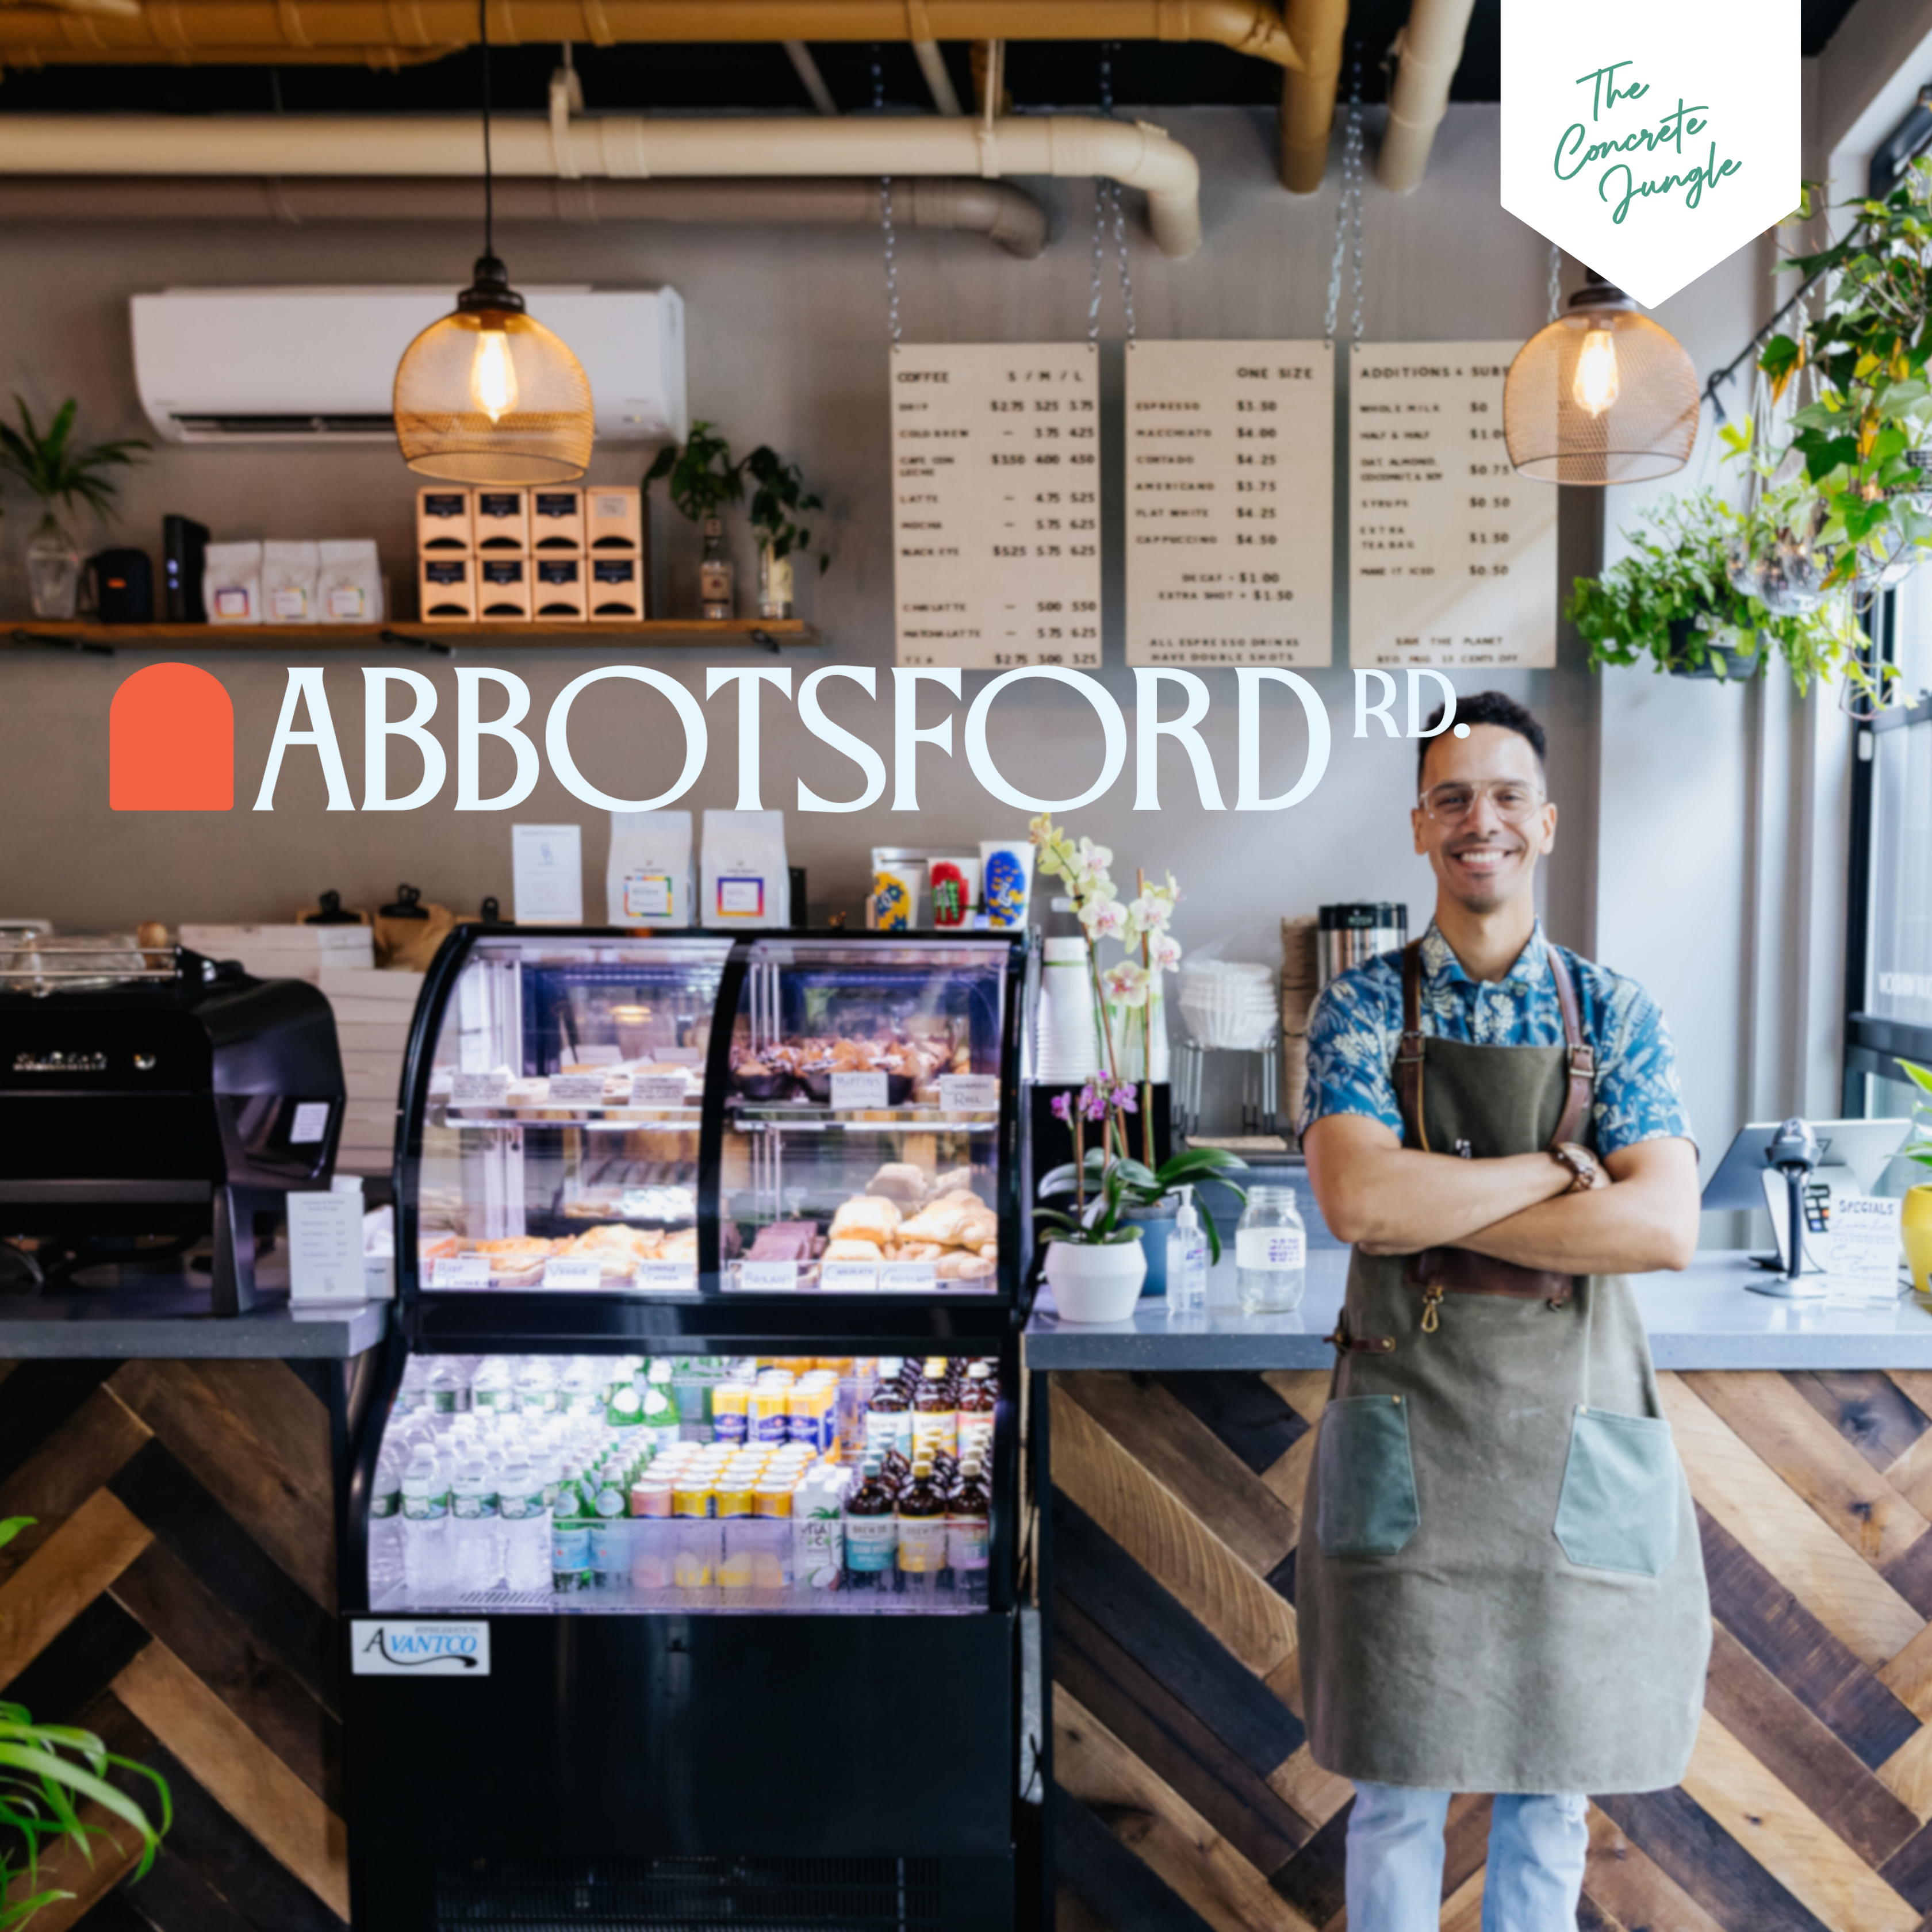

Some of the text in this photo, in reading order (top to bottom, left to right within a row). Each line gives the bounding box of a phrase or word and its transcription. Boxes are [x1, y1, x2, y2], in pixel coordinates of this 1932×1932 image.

[896, 371, 948, 383] COFFEE
[1007, 370, 1017, 382] S
[1038, 371, 1051, 381] M
[1073, 370, 1083, 382] L
[1236, 367, 1312, 379] ONE SIZE
[1360, 366, 1450, 379] ADDITIONS
[898, 402, 929, 412] DRIP
[1135, 401, 1201, 411] ESPRESSO
[1359, 401, 1488, 413] WHOLE MILK $0
[899, 430, 931, 439] COLD
[933, 429, 969, 438] BREW
[1136, 428, 1212, 438] MACCHIATO
[1360, 432, 1386, 440] HALF
[1404, 431, 1429, 440] HALF
[1136, 455, 1194, 465] CORTADO
[899, 467, 934, 477] LECHE
[1425, 472, 1443, 481] SOY
[1135, 482, 1214, 491] AMERICANO
[900, 494, 938, 504] LATTE
[1361, 499, 1409, 508] SYRUPS
[1135, 508, 1164, 518] FLAT
[1170, 509, 1208, 518] WHITE
[900, 522, 942, 530] MOCHA
[1359, 526, 1405, 535] EXTRA
[1136, 535, 1217, 544] CAPPUCCINO
[901, 548, 934, 557] BLACK
[938, 547, 959, 557] EYE
[1360, 568, 1385, 576] MAKE
[1390, 566, 1403, 576] IT
[1408, 566, 1435, 576] ICED
[1181, 573, 1222, 583] DECAF
[1158, 591, 1198, 600] EXTRA
[1203, 591, 1233, 600] SHOT
[930, 603, 966, 612] LATTE
[903, 629, 945, 638] MATCHA
[944, 628, 981, 639] LATTE
[1149, 638, 1299, 647] ALL ESPRESSO DRINKS
[1430, 637, 1452, 646] THE
[1463, 637, 1502, 646] PLANET
[904, 656, 934, 665] TEA
[1151, 652, 1294, 662] HAVE DOUBLE SHOTS
[1461, 654, 1494, 664] CENTS
[1498, 654, 1518, 663] OFF
[953, 1092, 981, 1106] ROLL
[1839, 1199, 1893, 1215] SPECIALS
[362, 1626, 478, 1668] AVANTCO
